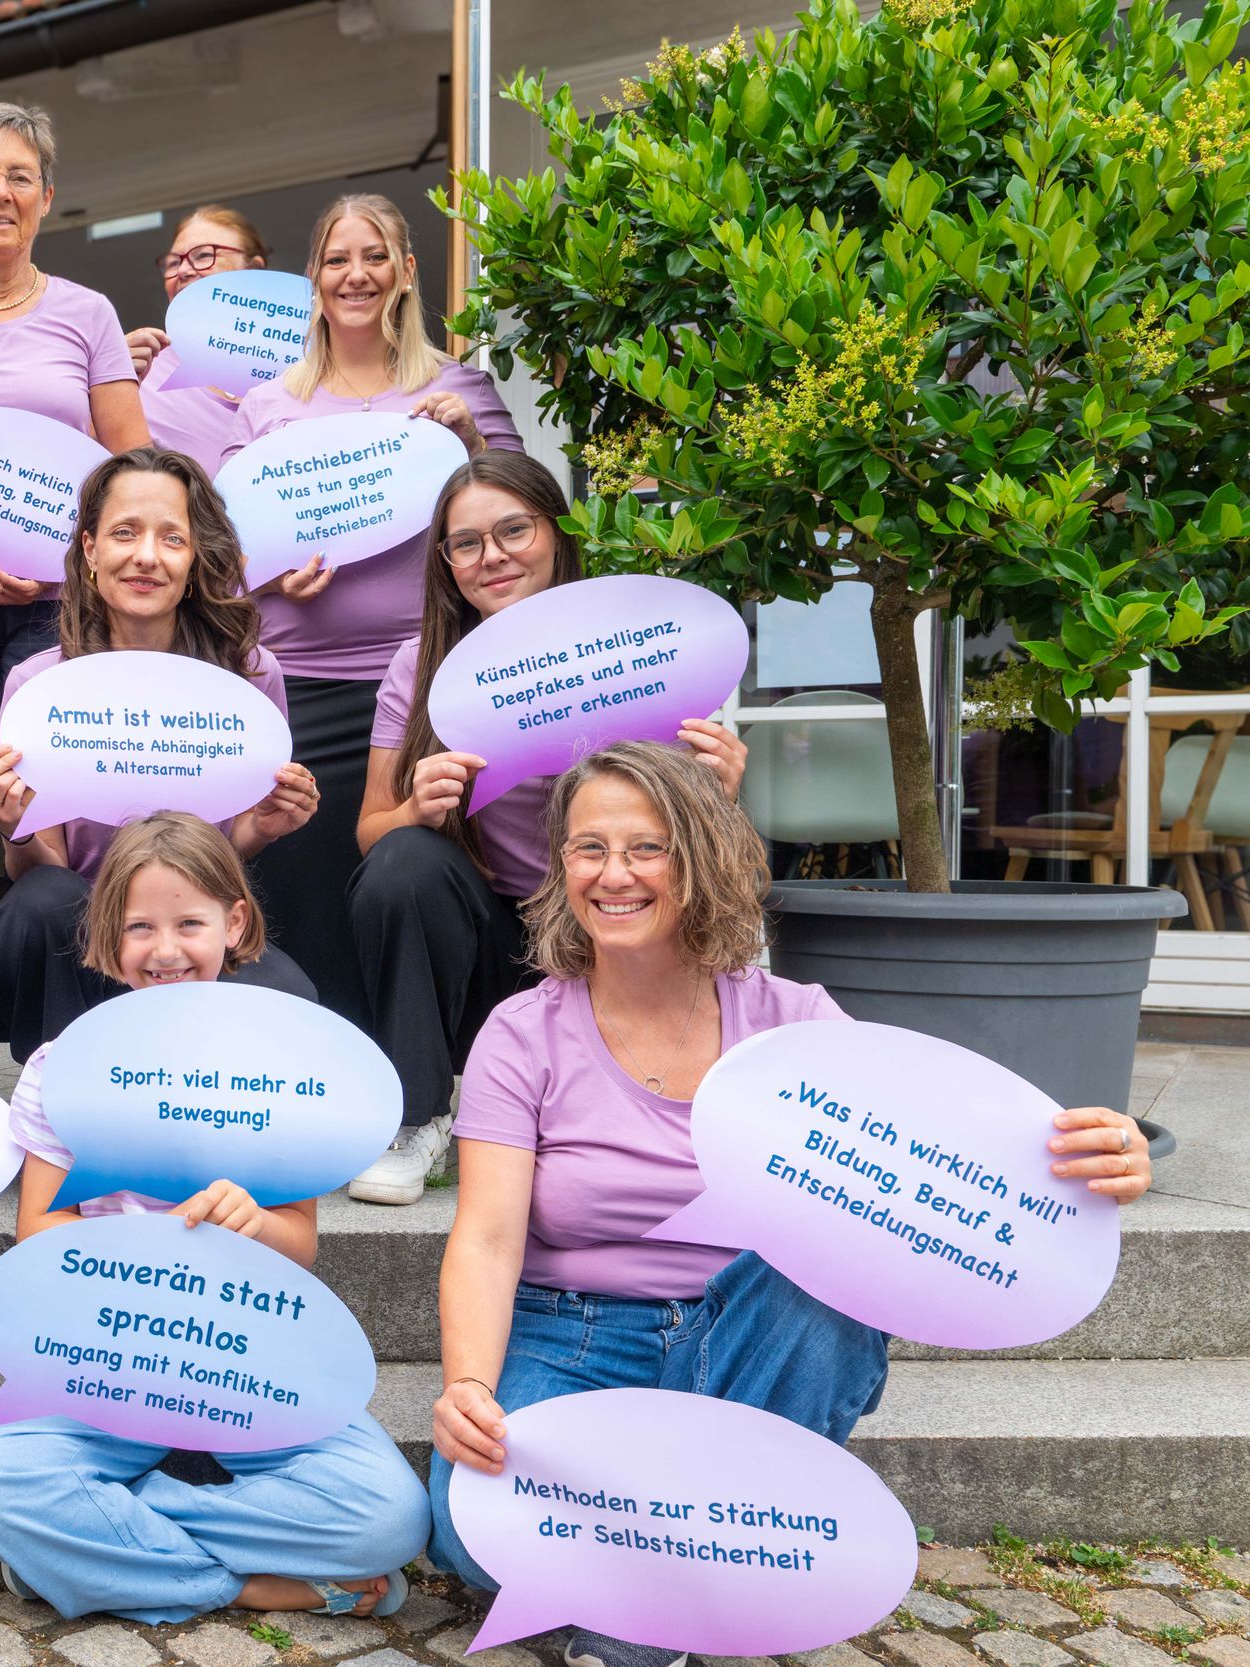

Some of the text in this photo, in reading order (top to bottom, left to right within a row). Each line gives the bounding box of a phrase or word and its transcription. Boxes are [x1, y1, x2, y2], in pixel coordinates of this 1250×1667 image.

[211, 287, 309, 320] Frauengesun
[234, 317, 256, 335] ist
[208, 335, 279, 363] körperlich,
[250, 368, 277, 381] sozi
[252, 432, 411, 486] „Aufschieberitis“
[18, 467, 73, 496] wirklich
[276, 467, 393, 501] Was tun gegen
[22, 491, 66, 516] Beruf
[68, 508, 79, 523] &
[295, 491, 385, 521] ungewolltes
[296, 508, 393, 543] Aufschieben?
[475, 621, 682, 687] Künstliche Intelligenz,
[491, 648, 678, 710] Deepfakes und mehr
[47, 705, 245, 732] Armut ist weiblich
[517, 680, 666, 731] sicher erkennen
[50, 734, 245, 759] Ökonomische Abhängigkeit
[95, 760, 203, 777] & Altersarmut
[109, 1066, 326, 1097] Sport: viel mehr als
[158, 1101, 271, 1132] Bewegung!
[778, 1080, 1077, 1225] „Was ich wirklich will“
[804, 1129, 1015, 1246] Bildung, Beruf &
[765, 1154, 1018, 1289] Entscheidungsmacht
[60, 1248, 306, 1321] Souverän statt
[97, 1307, 248, 1355] sprachlos
[34, 1335, 300, 1407] Umgang mit Konflikten
[65, 1375, 253, 1430] sicher meistern!
[514, 1475, 838, 1542] Methoden zur Stärkung
[538, 1515, 815, 1572] der Selbstsicherheit
